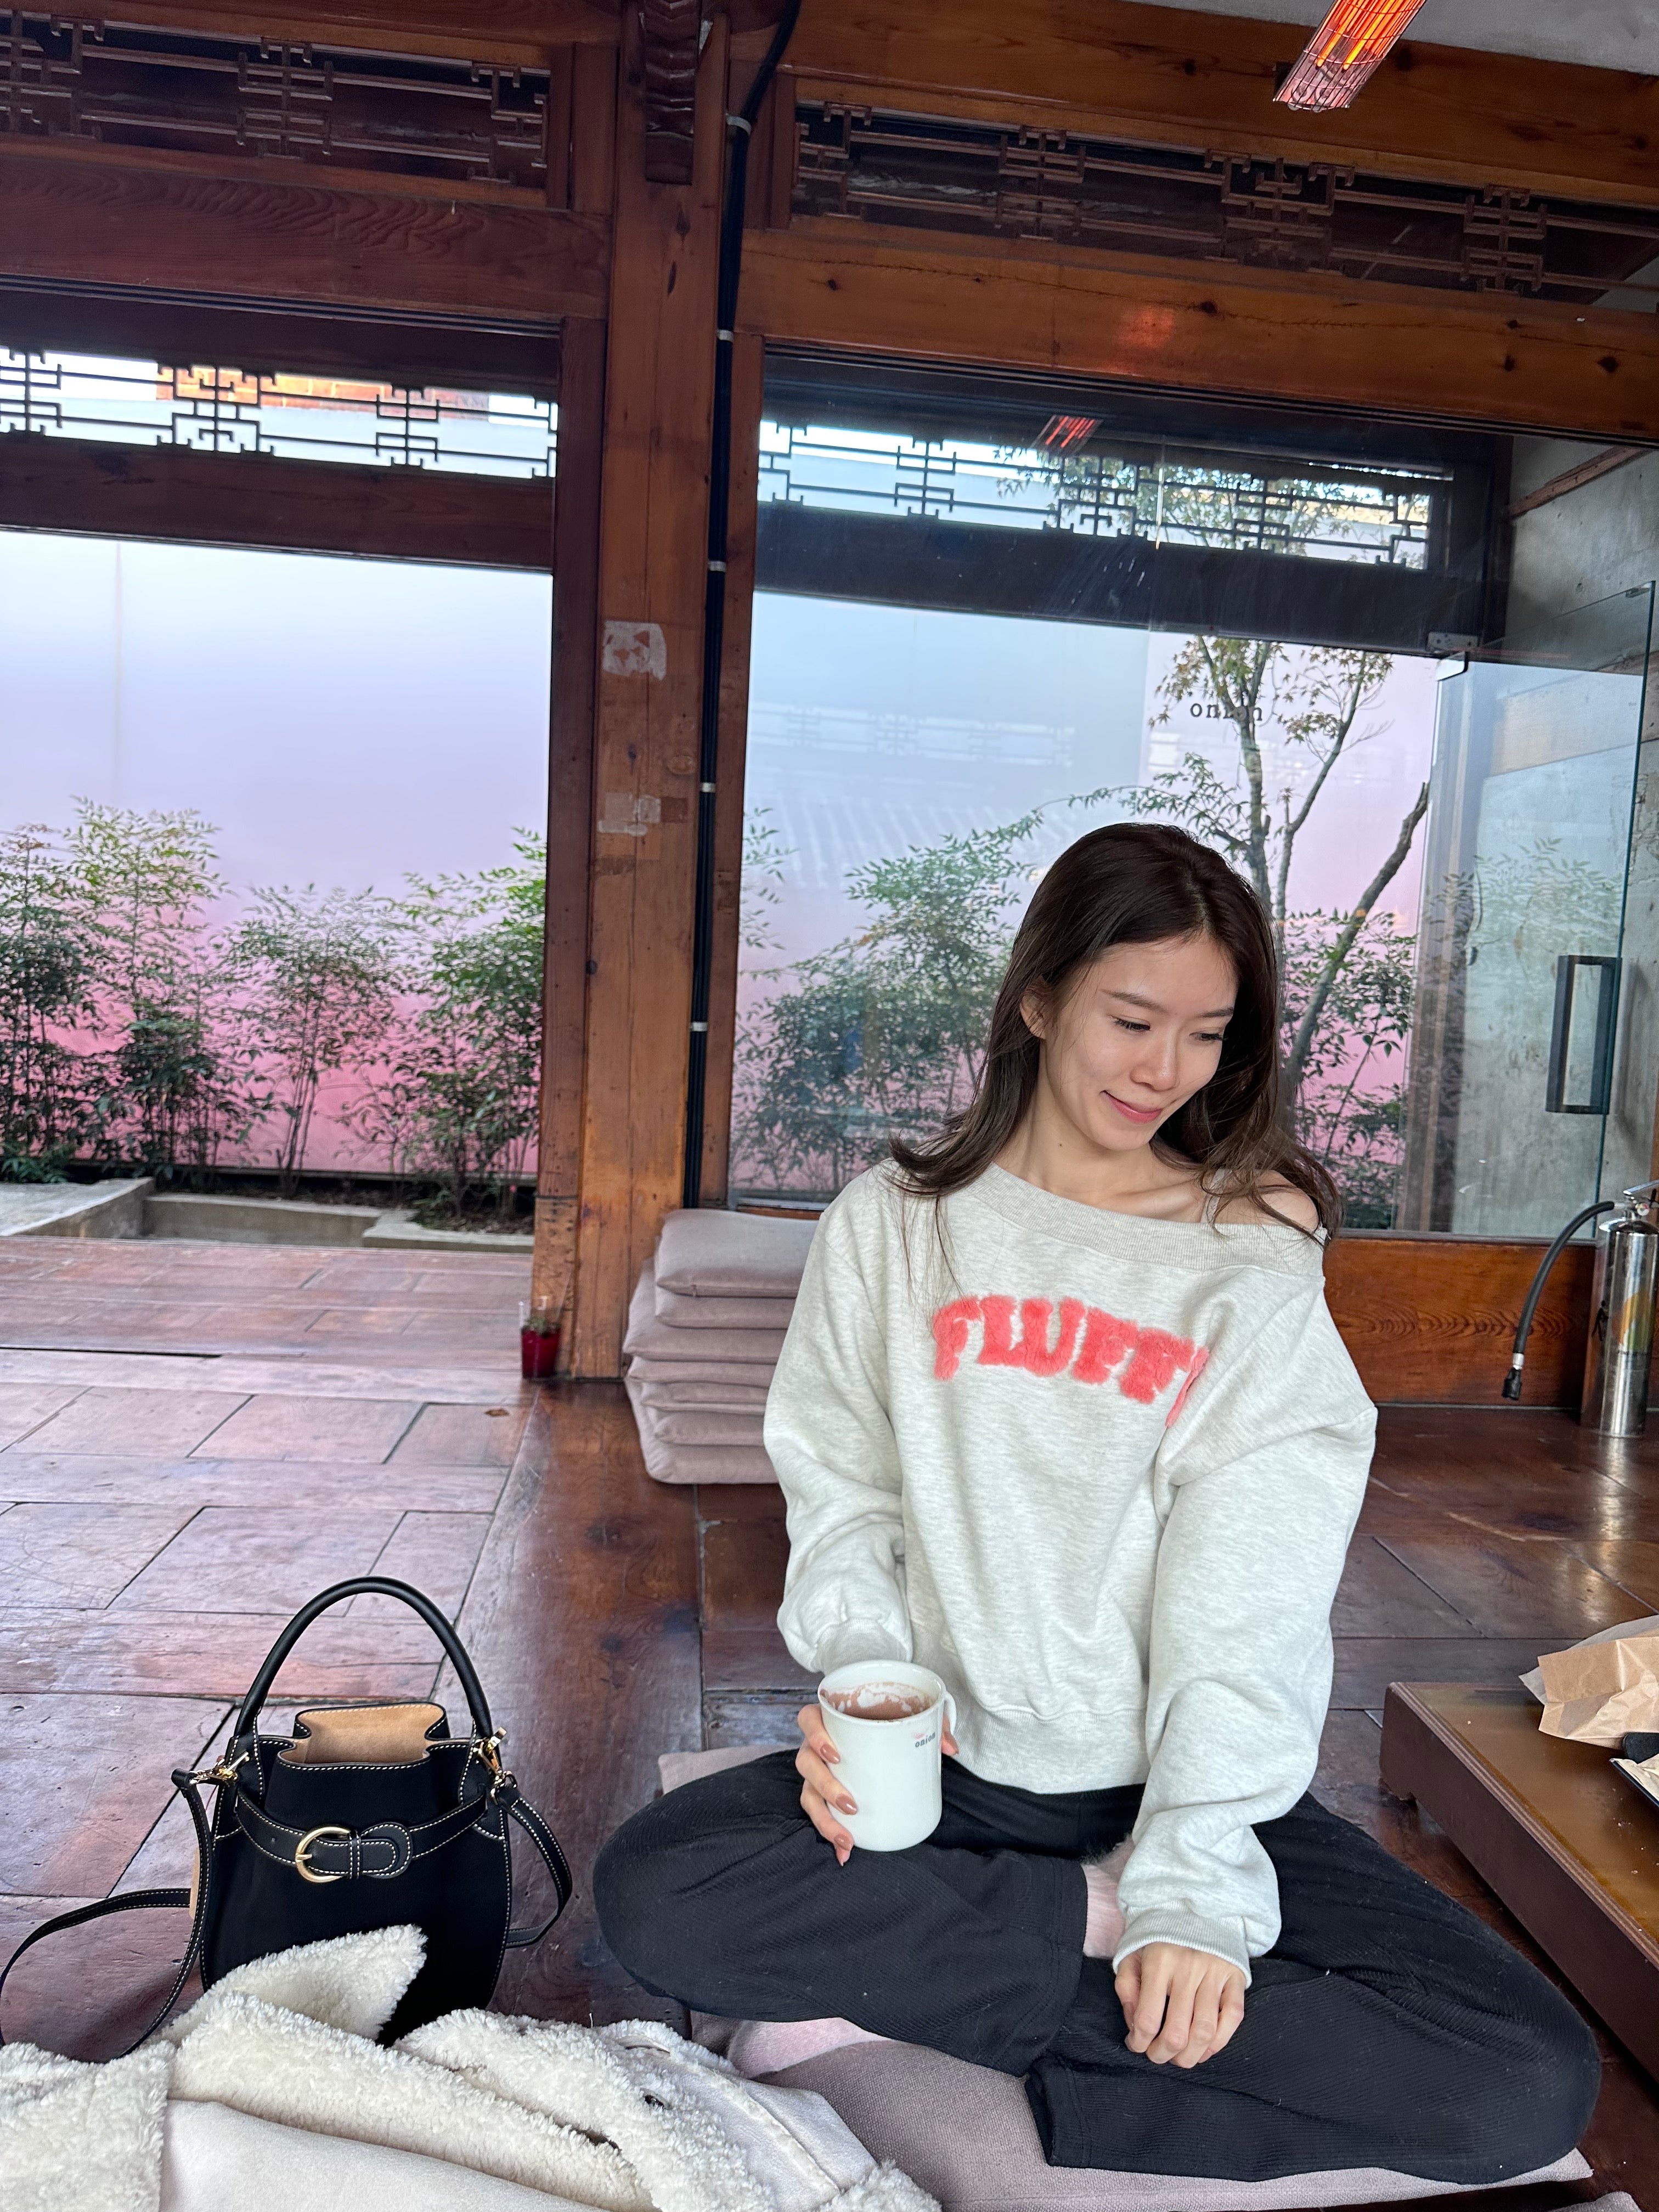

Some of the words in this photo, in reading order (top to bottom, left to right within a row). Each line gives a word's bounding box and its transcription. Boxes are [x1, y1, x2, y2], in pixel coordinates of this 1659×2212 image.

[1190, 703, 1262, 721] onn
[933, 1295, 1209, 1427] FLUFF
[915, 1732, 935, 1747] onion
